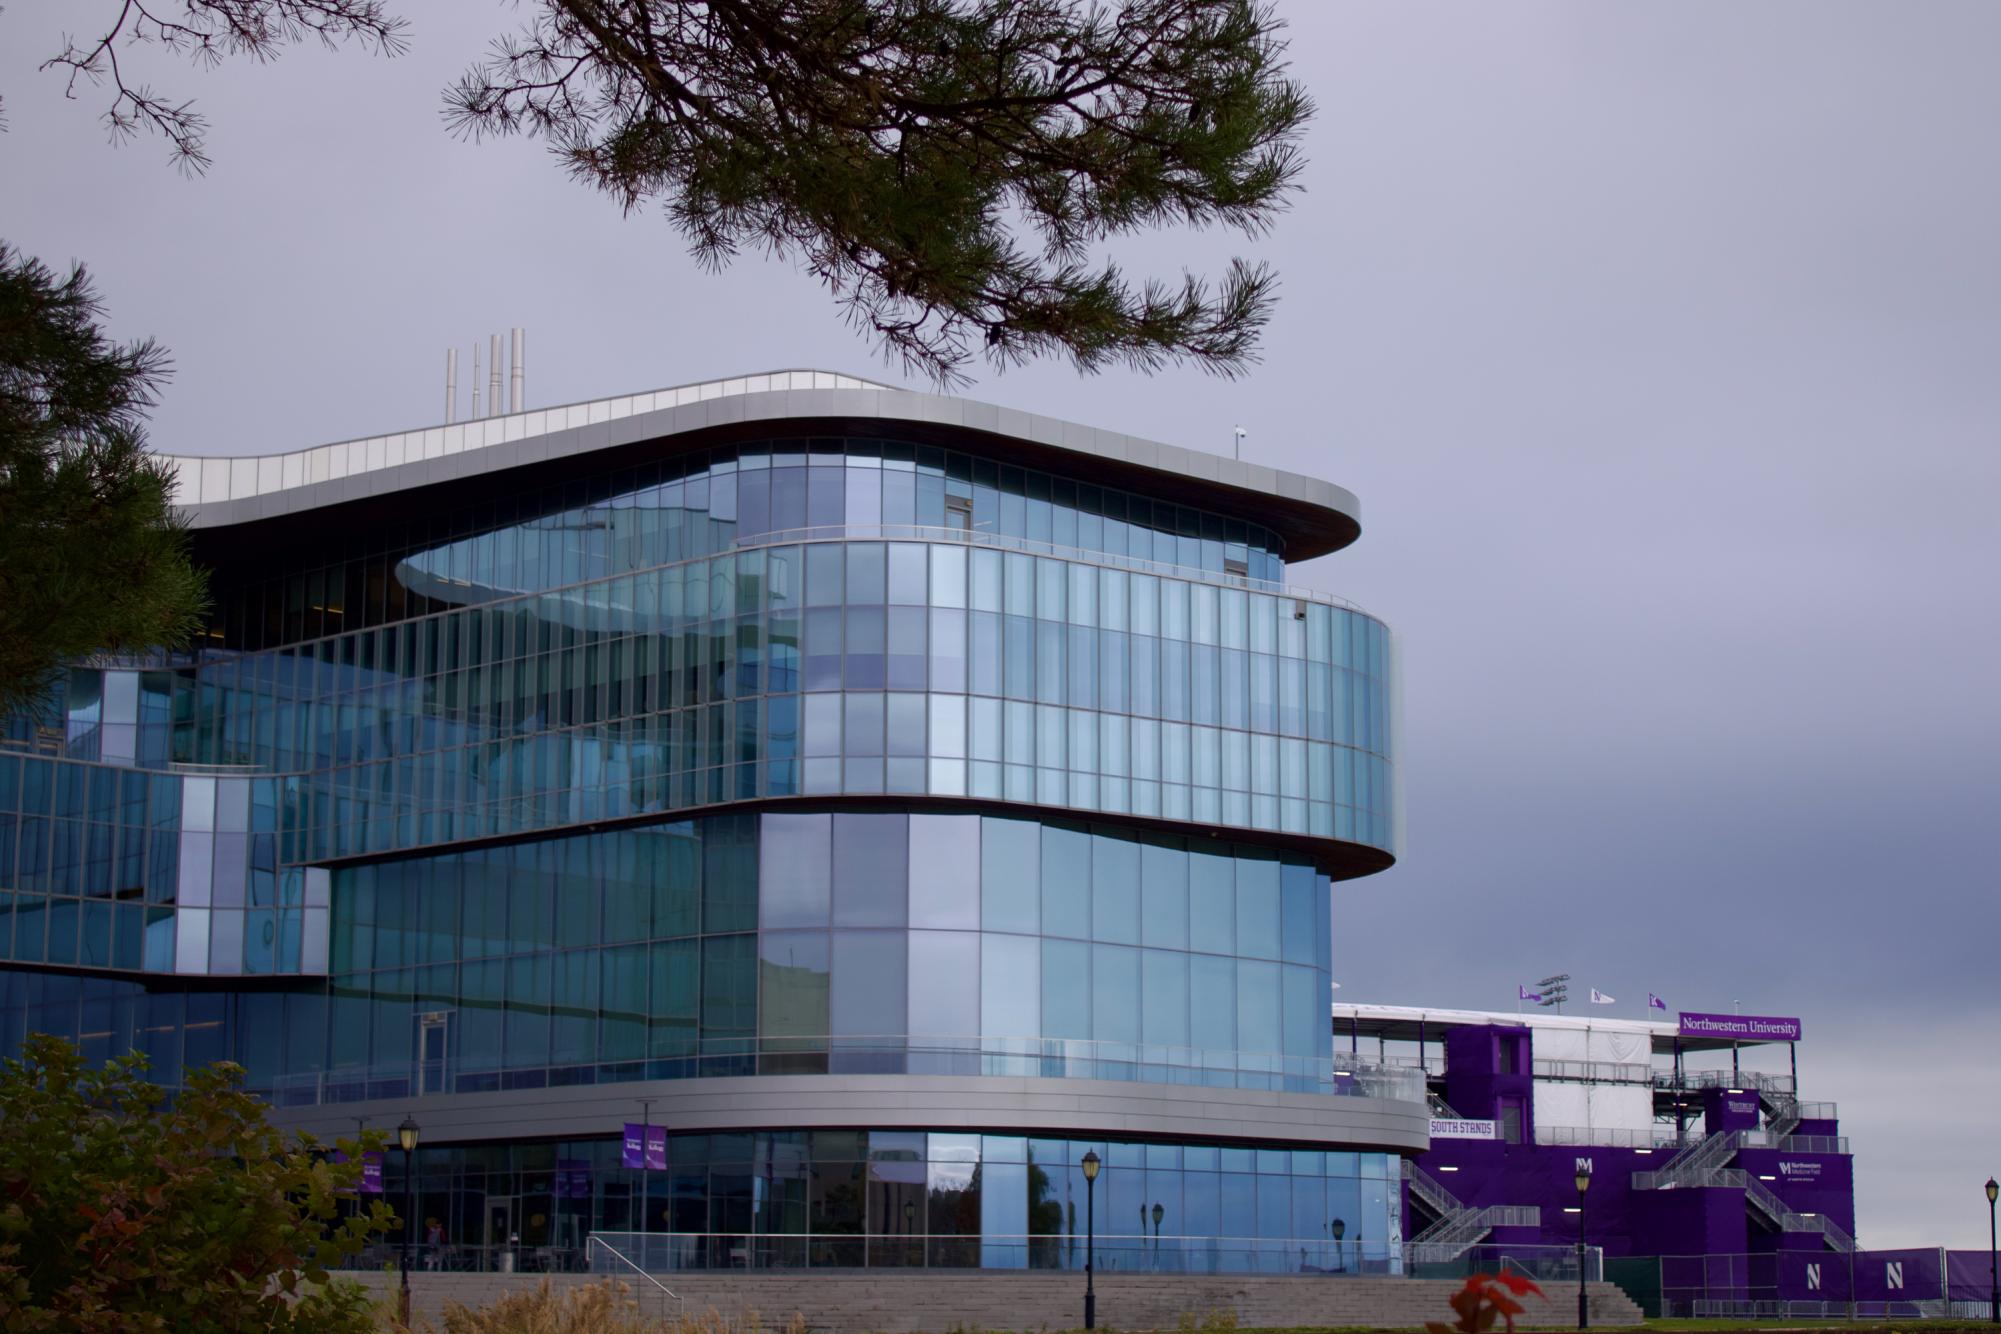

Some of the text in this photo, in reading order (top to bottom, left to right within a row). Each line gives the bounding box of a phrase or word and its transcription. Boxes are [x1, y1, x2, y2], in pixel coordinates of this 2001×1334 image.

[1683, 1017, 1797, 1037] Northwestern University
[1431, 1121, 1492, 1134] SOUTH STANDS
[1807, 1263, 1820, 1290] N
[1887, 1262, 1903, 1289] N
